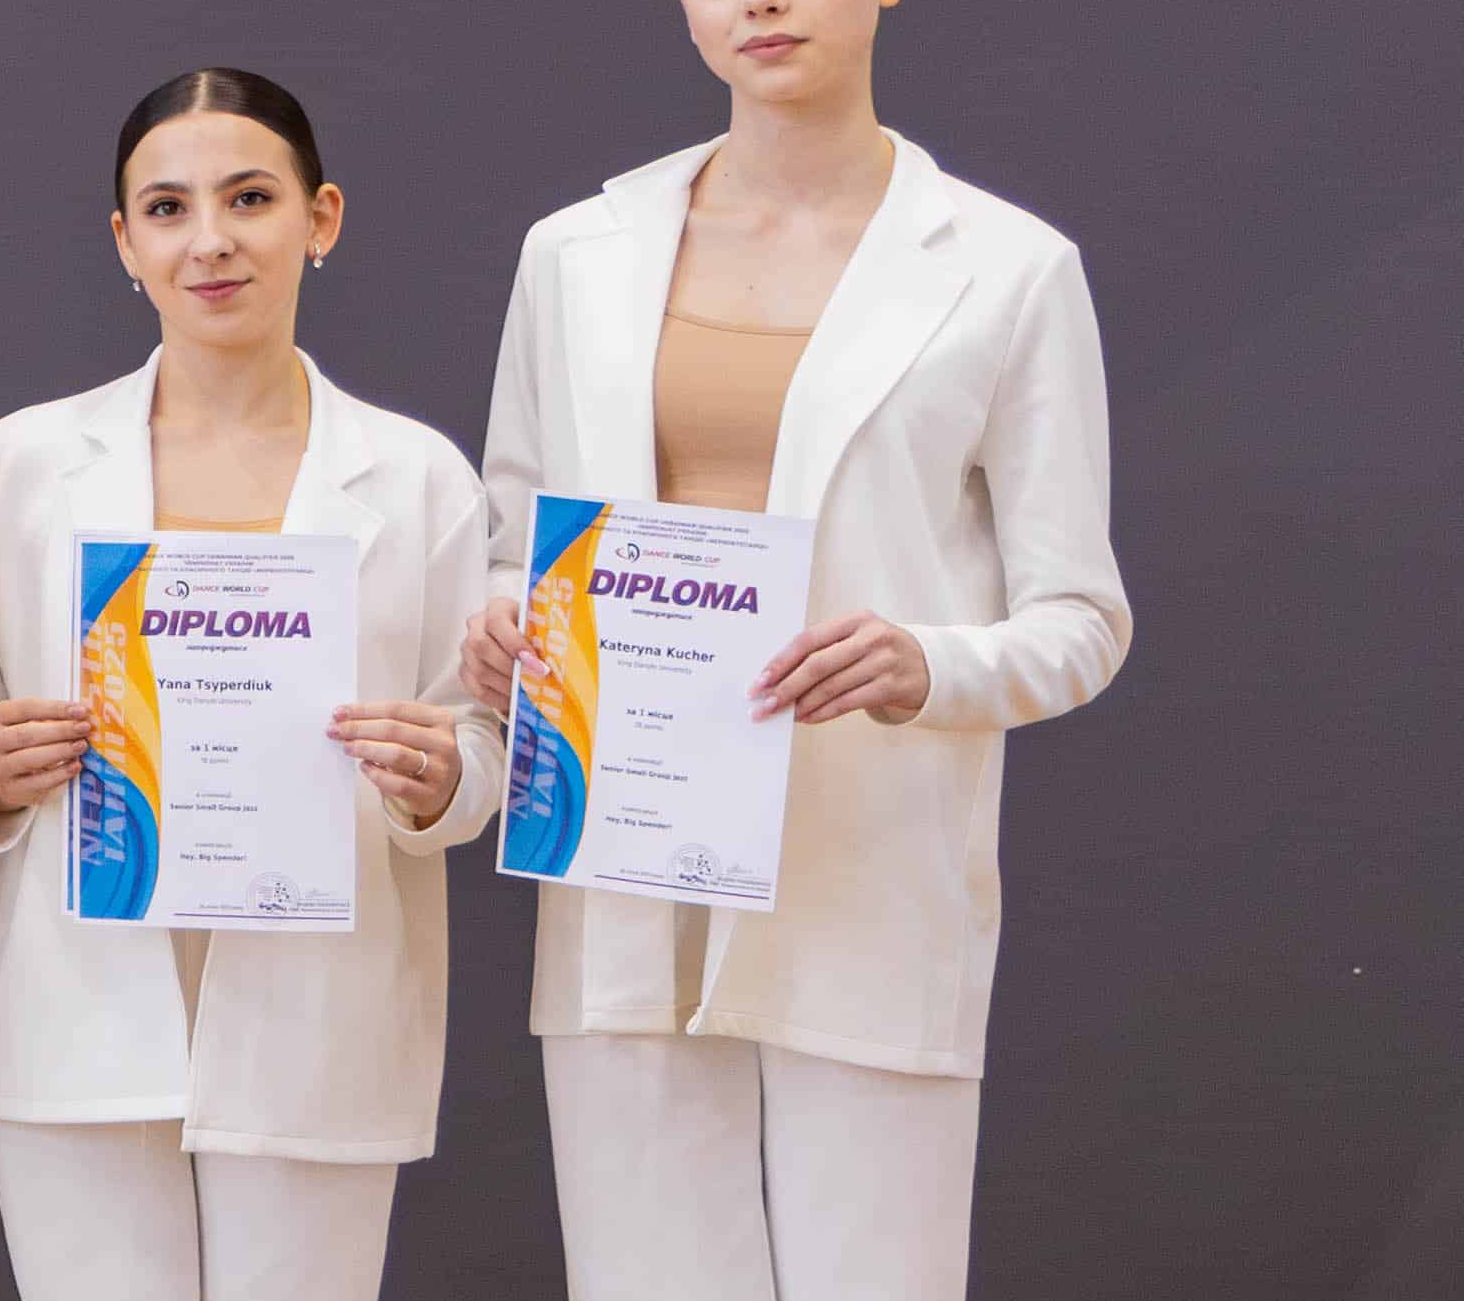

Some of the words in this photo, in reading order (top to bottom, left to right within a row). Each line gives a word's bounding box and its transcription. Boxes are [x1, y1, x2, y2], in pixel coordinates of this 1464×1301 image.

[642, 549, 671, 559] DANCE
[673, 553, 703, 561] WORLD
[192, 585, 221, 593] DANCE
[222, 585, 251, 593] WORLD
[588, 569, 758, 613] DIPLOMA
[140, 610, 312, 638] DIPLOMA
[599, 638, 662, 659] Kateryna
[666, 647, 716, 663] Kucher
[157, 678, 191, 691] Yana
[196, 679, 273, 693] Tsyperdiuk
